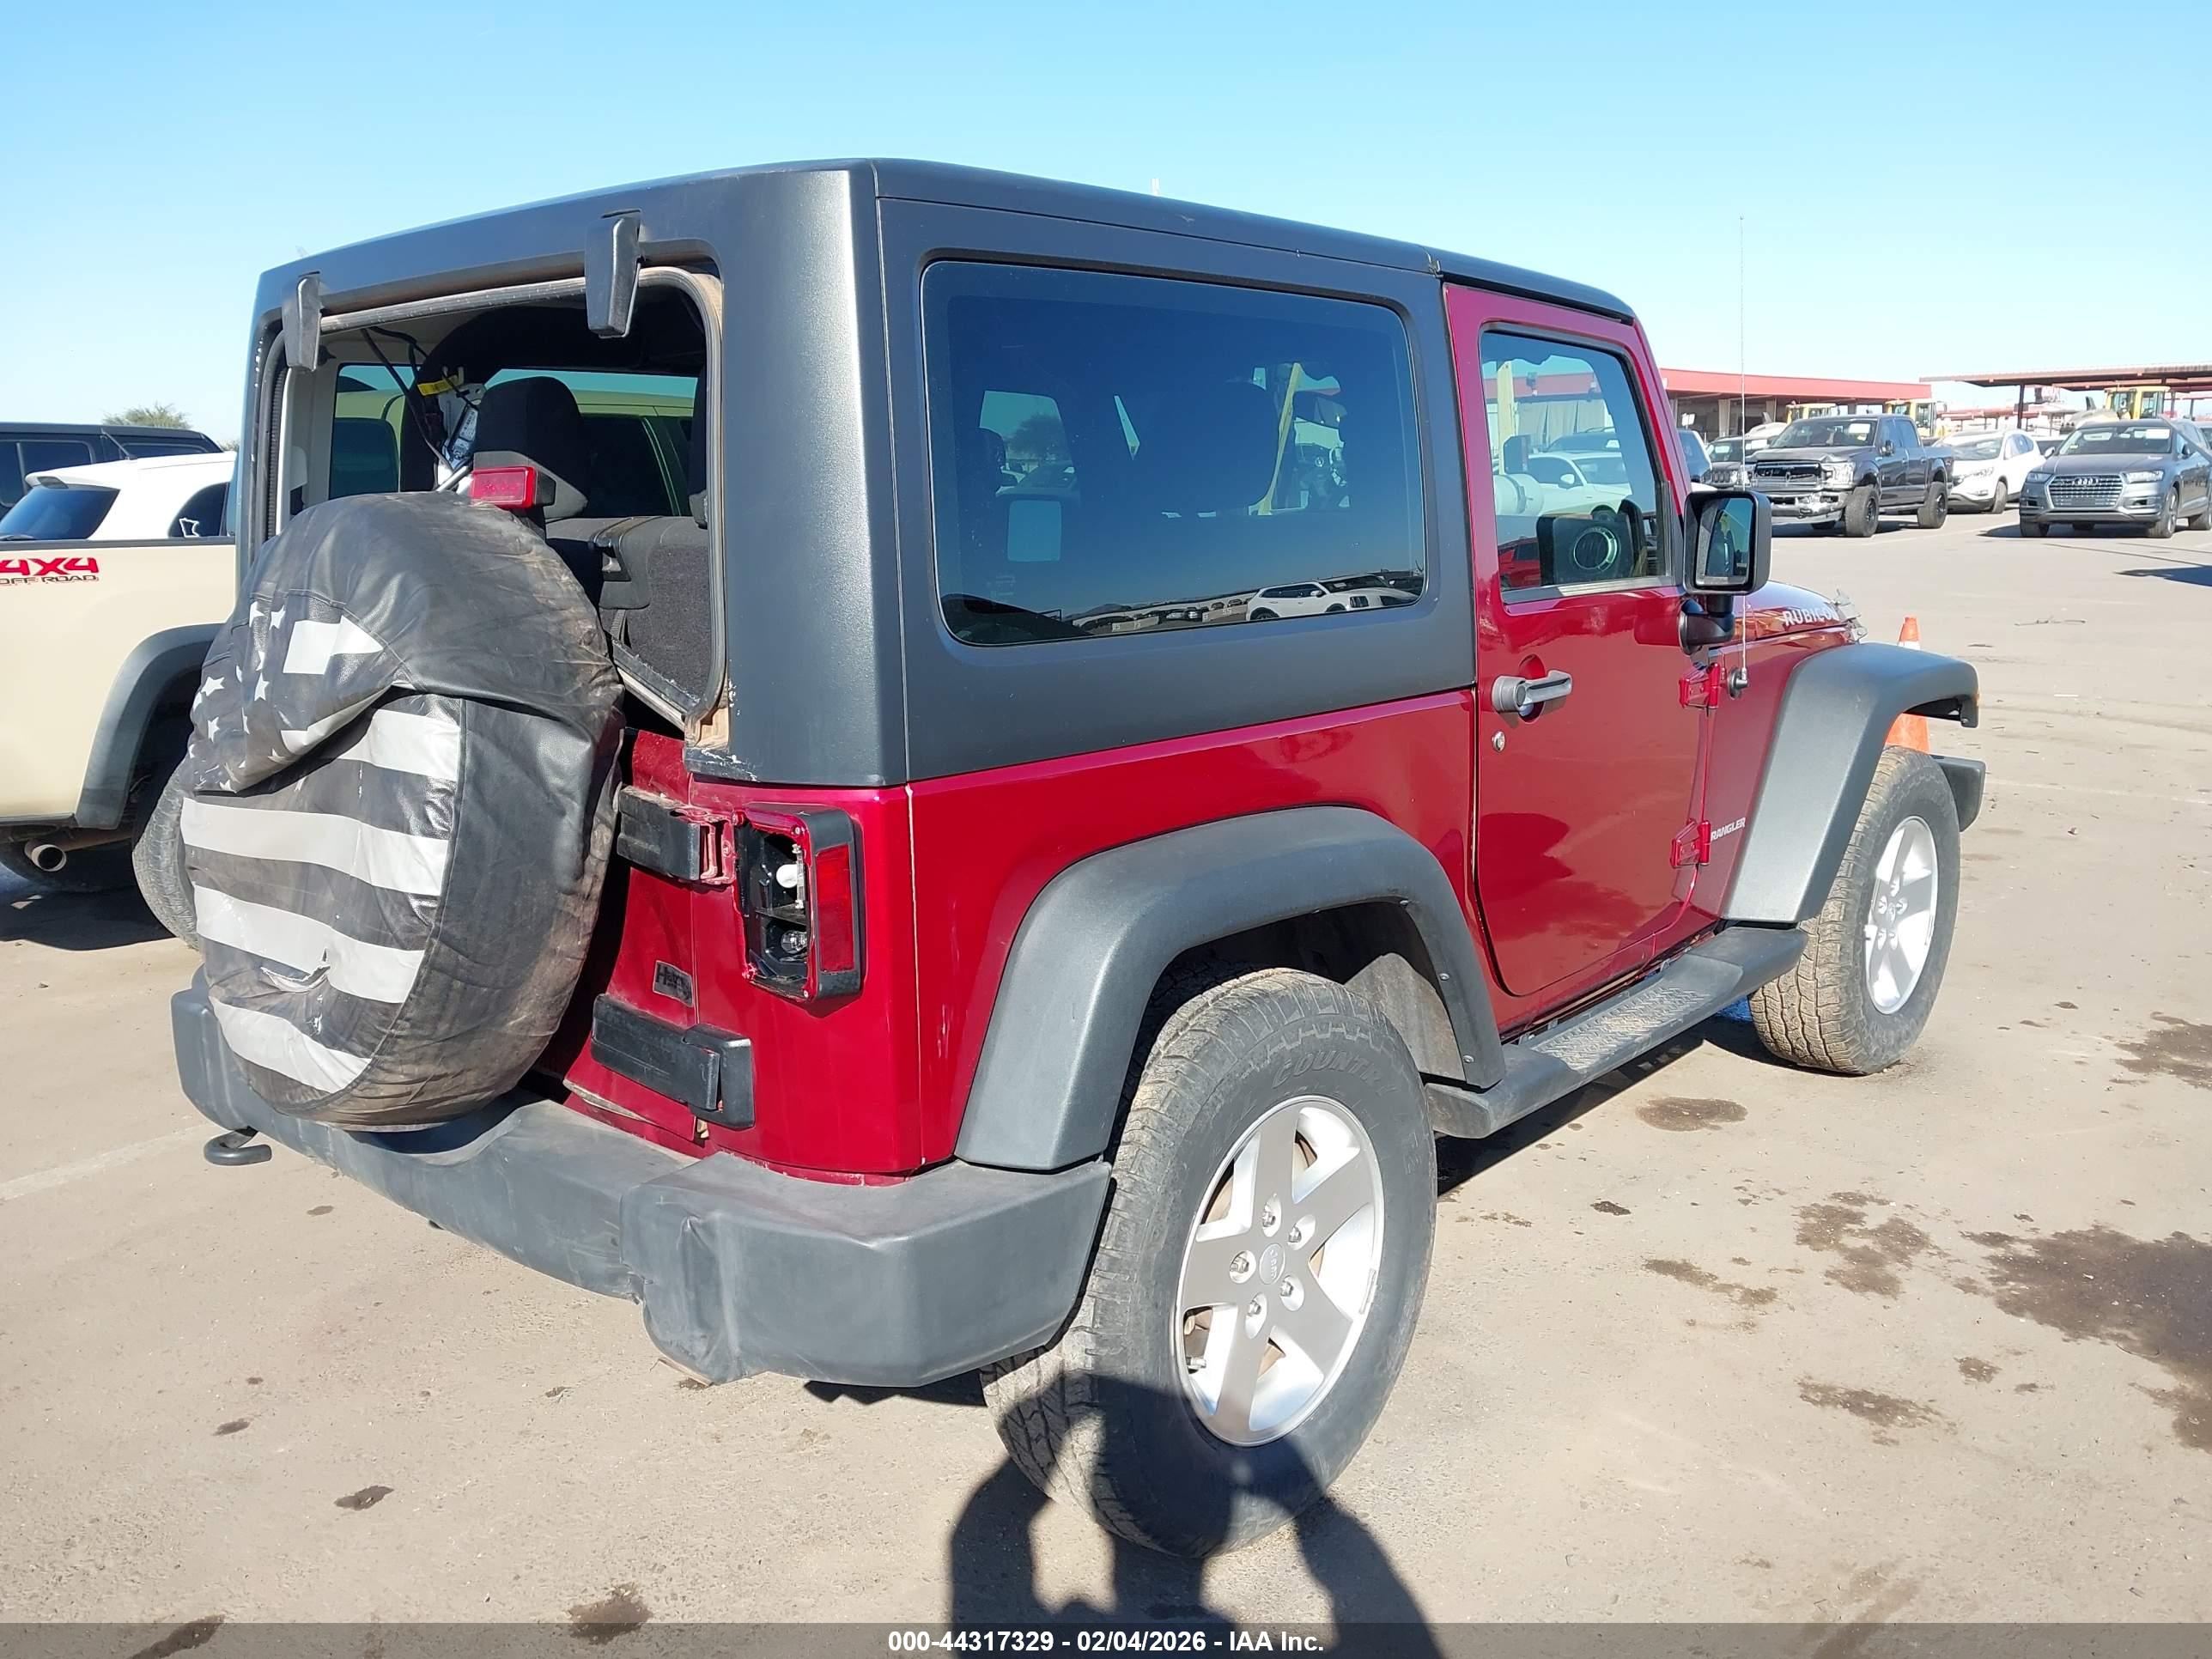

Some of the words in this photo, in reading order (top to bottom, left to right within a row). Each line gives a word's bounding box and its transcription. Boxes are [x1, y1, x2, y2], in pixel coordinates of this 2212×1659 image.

[0, 576, 37, 586] OFF
[40, 574, 99, 584] ROAD
[1711, 817, 1746, 842] RANGLER
